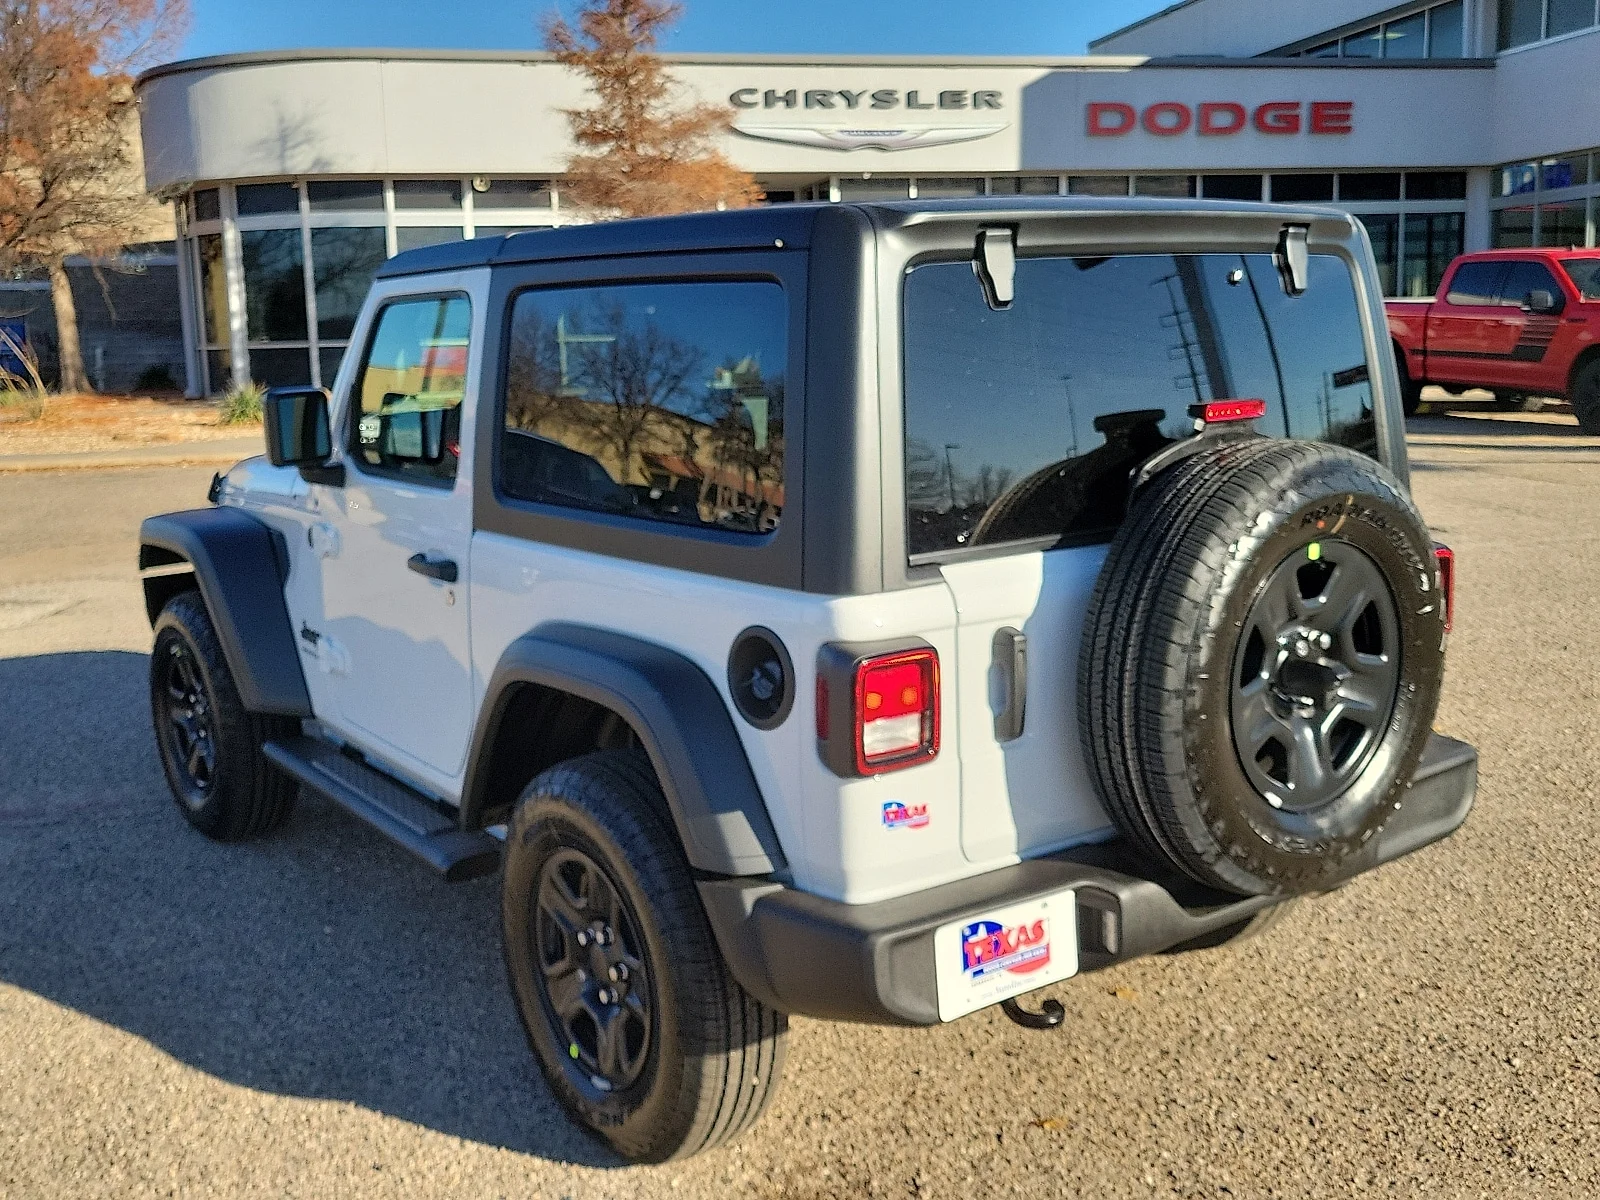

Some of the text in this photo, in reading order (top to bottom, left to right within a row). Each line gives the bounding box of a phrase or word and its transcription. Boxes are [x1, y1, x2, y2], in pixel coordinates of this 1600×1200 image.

[729, 88, 1003, 110] CHRYSLER
[1086, 101, 1353, 136] DODGE
[963, 919, 1046, 968] TEXAS
